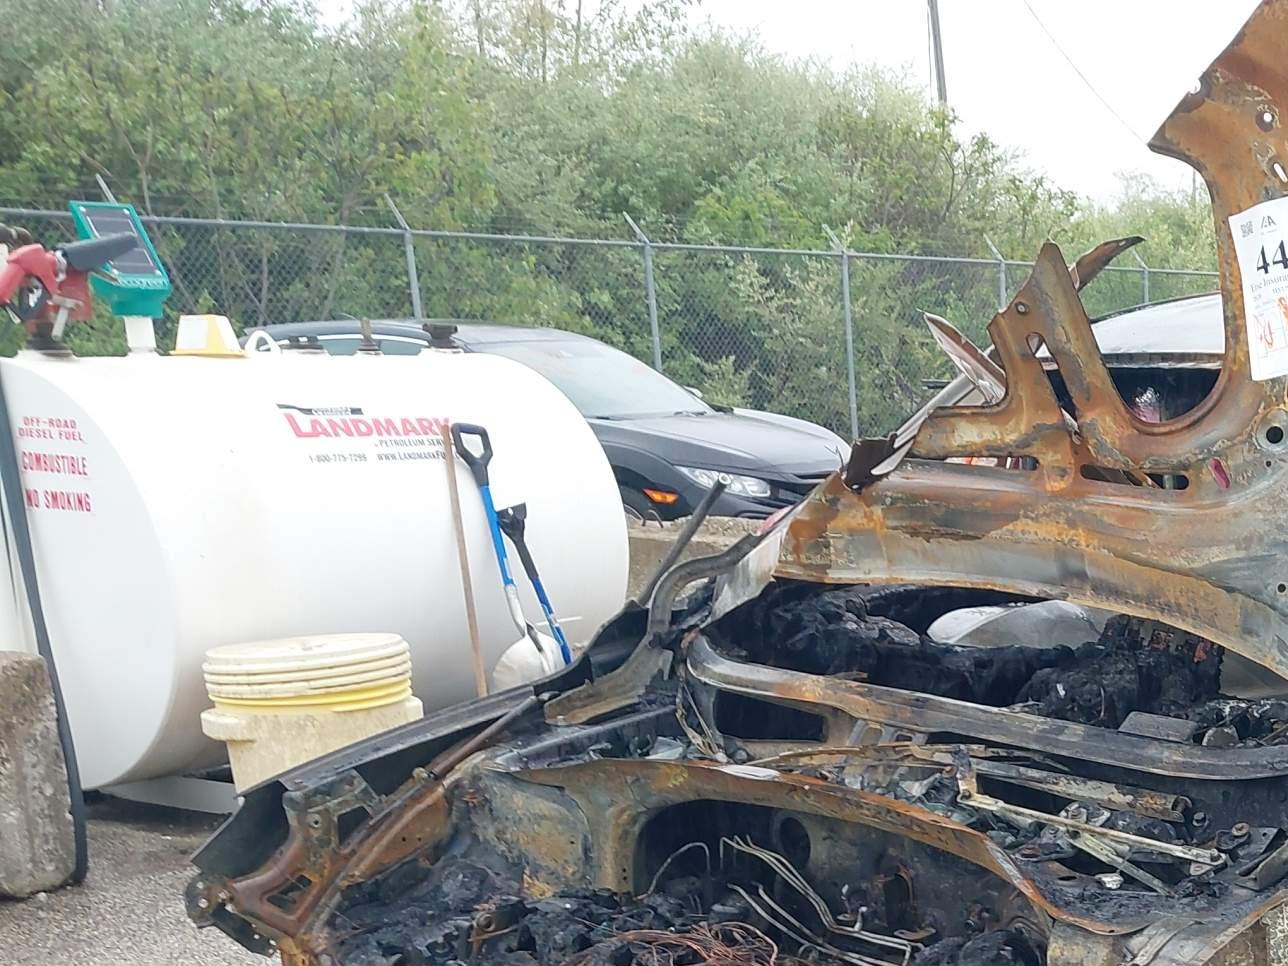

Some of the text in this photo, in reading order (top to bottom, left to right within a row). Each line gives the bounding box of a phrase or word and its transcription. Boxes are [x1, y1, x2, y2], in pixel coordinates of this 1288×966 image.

[23, 416, 77, 429] OFF-ROAD
[18, 428, 84, 441] DIESEL FUEL
[22, 451, 88, 476] COMBUSTIBLE
[25, 488, 91, 512] NO SMOKING
